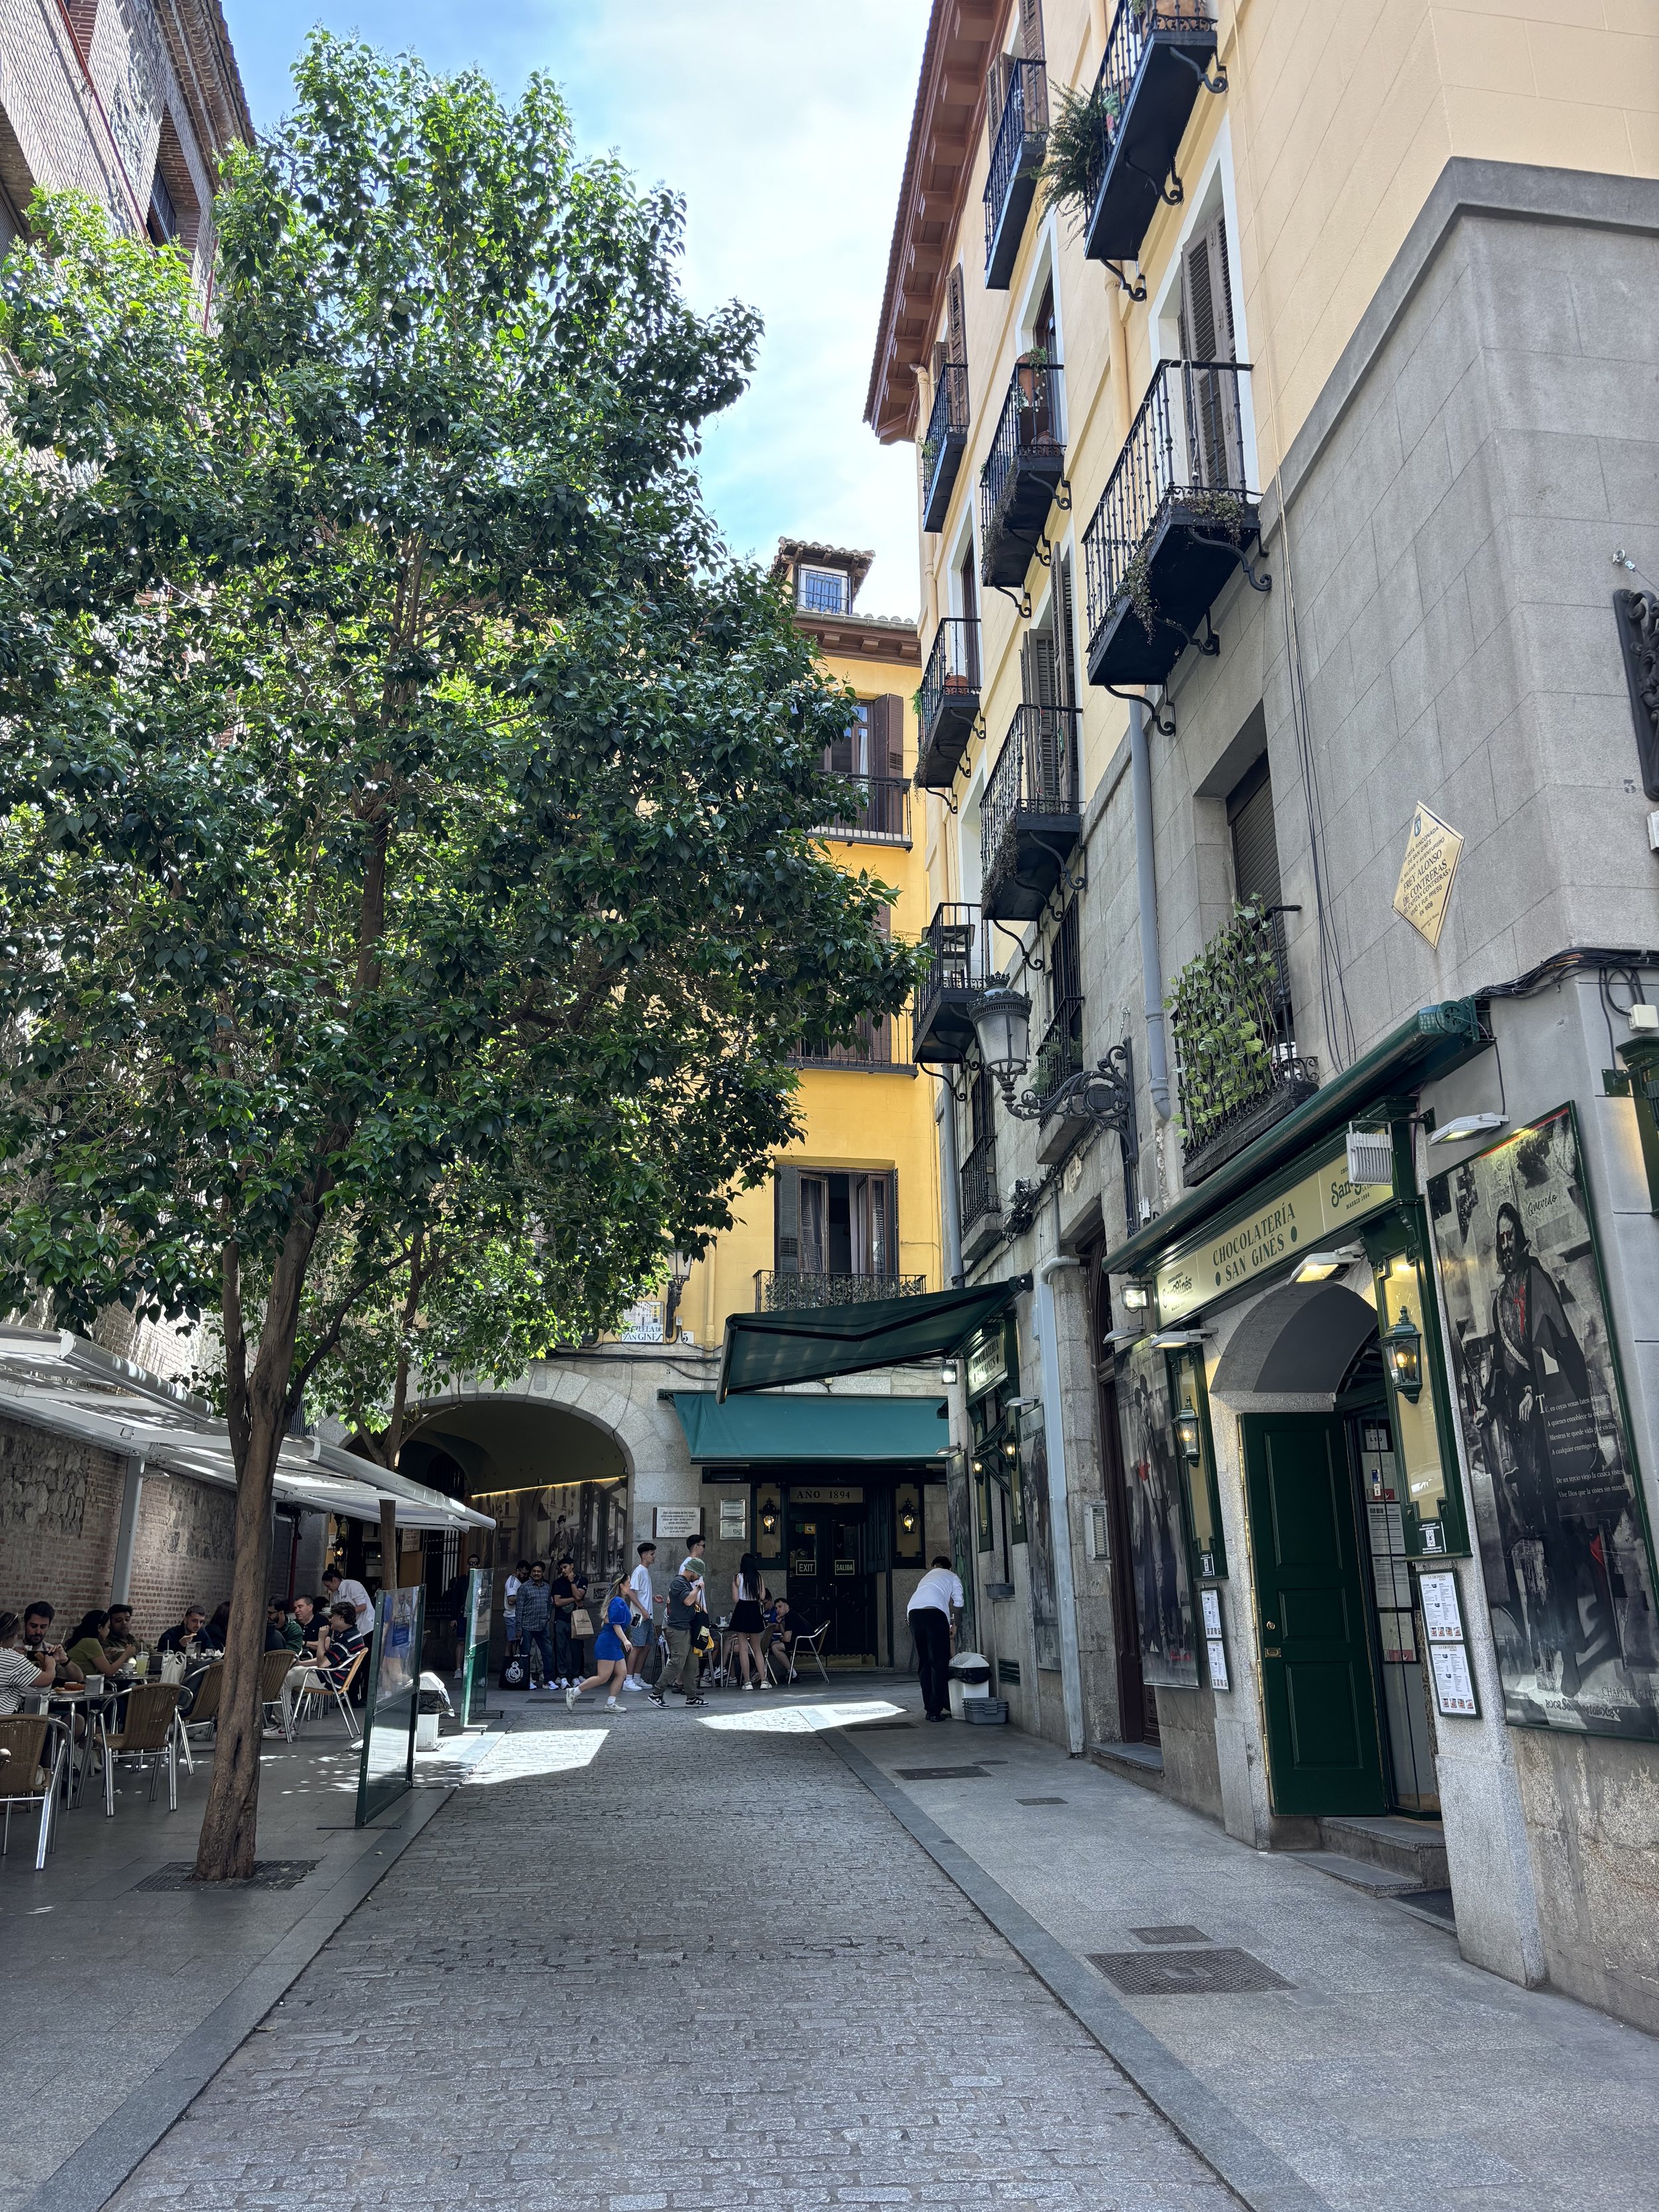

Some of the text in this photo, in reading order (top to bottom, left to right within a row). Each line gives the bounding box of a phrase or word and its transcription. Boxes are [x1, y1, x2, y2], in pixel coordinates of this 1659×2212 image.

[1415, 826, 1439, 849] RINCONADA
[1419, 837, 1445, 862] AVENTURERO
[1404, 849, 1442, 893] FREY ALONSO
[1403, 859, 1447, 907] DE CONTRERAS
[1429, 884, 1443, 899] PRESO
[1346, 1197, 1360, 1211] MADRID
[1528, 1191, 1558, 1217] Quevedo
[1212, 1202, 1296, 1267] CHOCOLATERÍA
[1225, 1233, 1285, 1282] SAN GINÉS
[682, 1333, 688, 1342] 5
[1556, 1403, 1567, 1412] cuyas
[1551, 1418, 1567, 1428] quienes
[1567, 1413, 1587, 1423] ennoblece
[1571, 1428, 1584, 1438] quede
[1555, 1446, 1574, 1455] cualquier
[797, 1489, 851, 1499] AÑO 1894
[799, 1564, 814, 1572] EXIT
